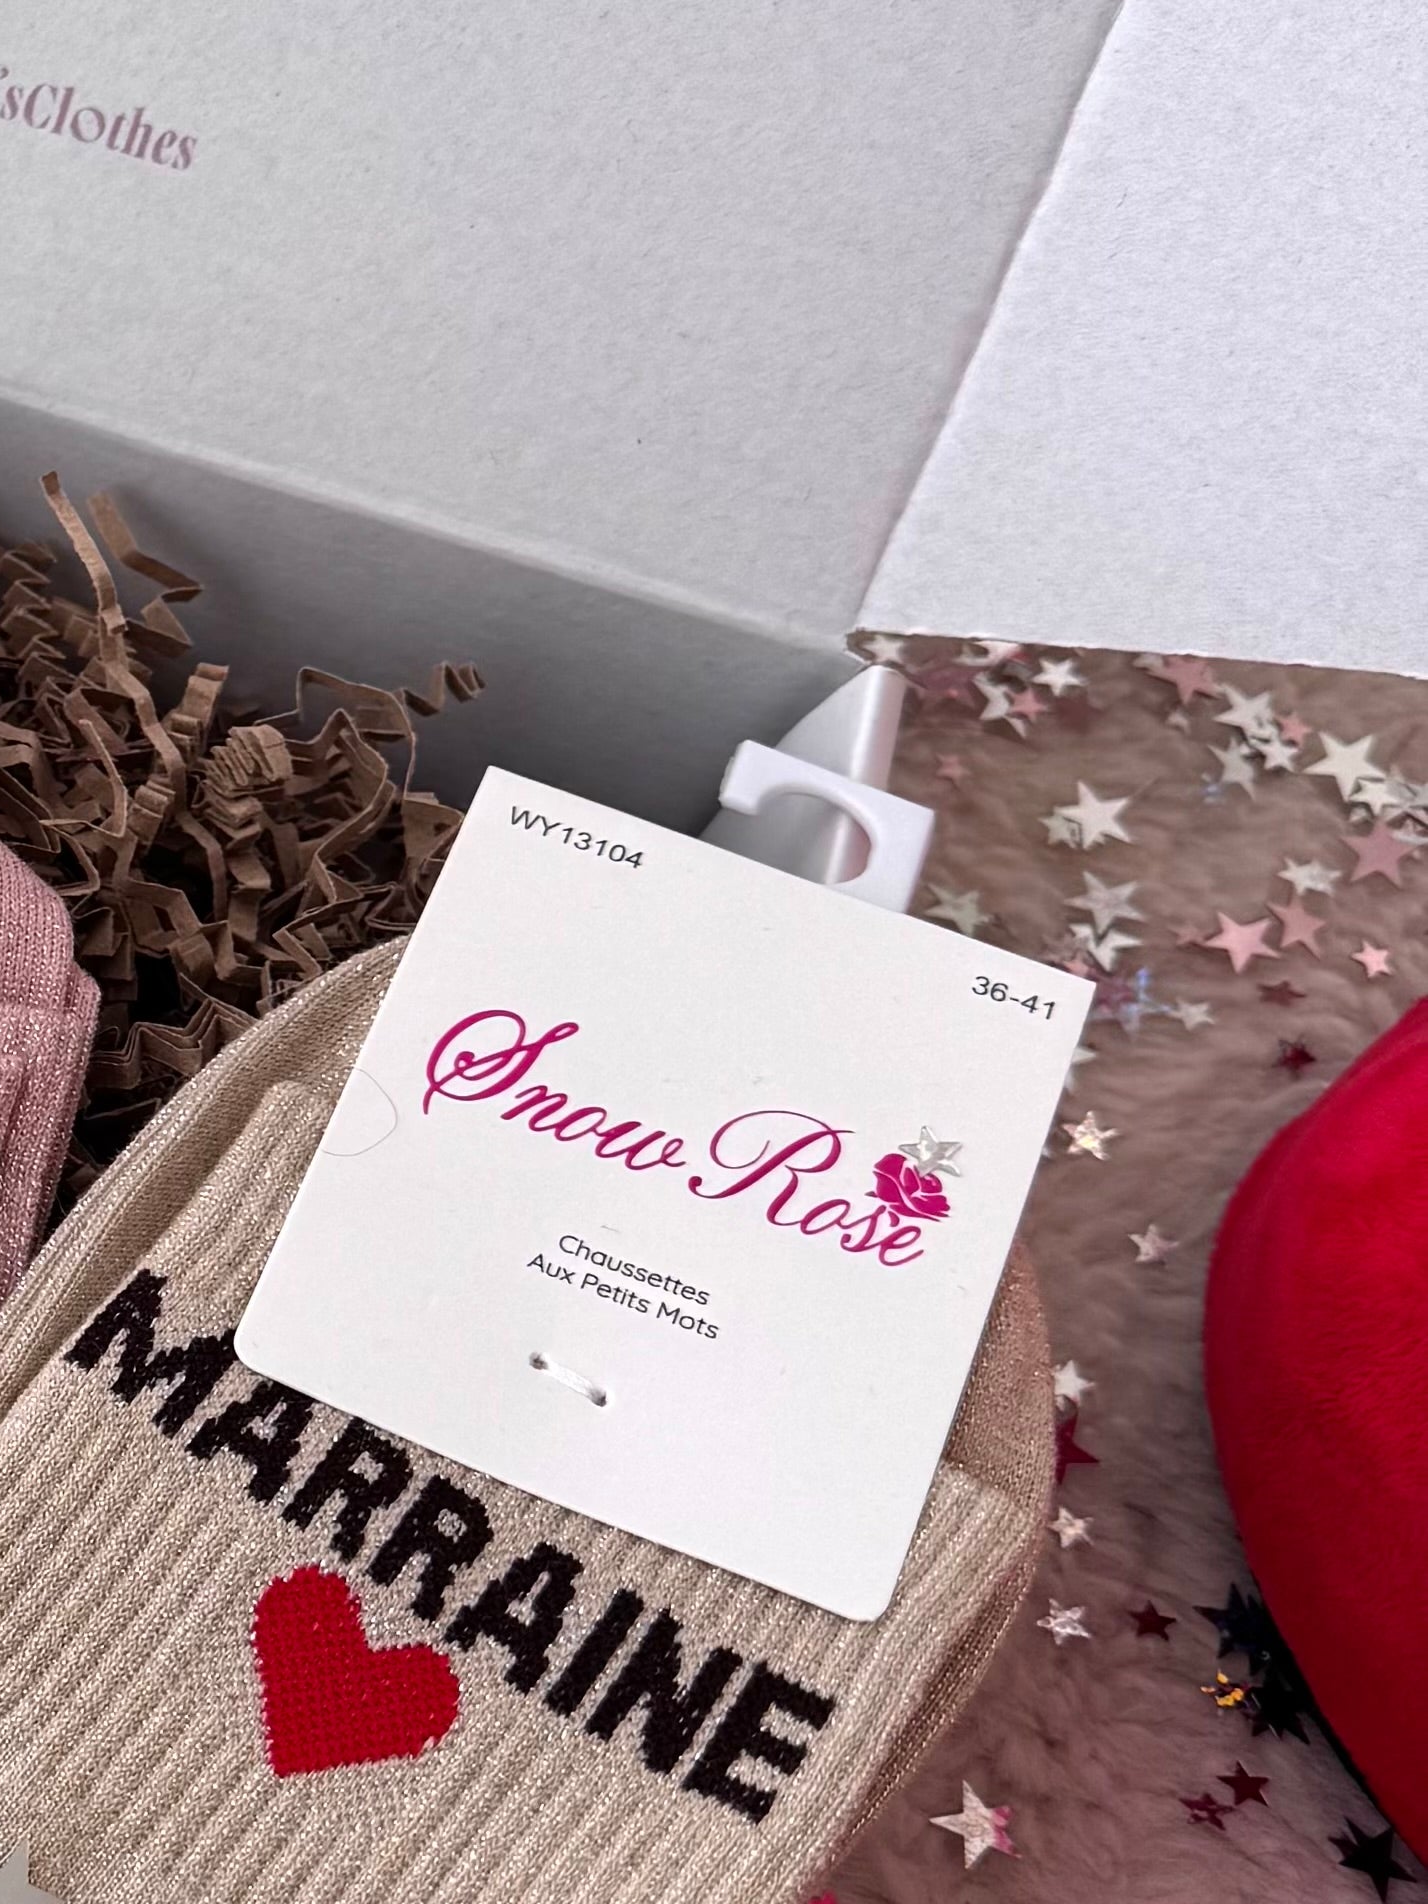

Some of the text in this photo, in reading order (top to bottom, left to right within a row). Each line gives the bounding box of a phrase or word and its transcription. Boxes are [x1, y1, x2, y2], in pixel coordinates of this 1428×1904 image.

[510, 805, 644, 870] WY13104
[970, 974, 1057, 1020] 36-41
[422, 1008, 927, 1268] Snow Rose
[526, 1252, 720, 1340] Aux Petits Mots
[556, 1234, 710, 1307] Chaussettes
[64, 1268, 836, 1825] MARRAINE
